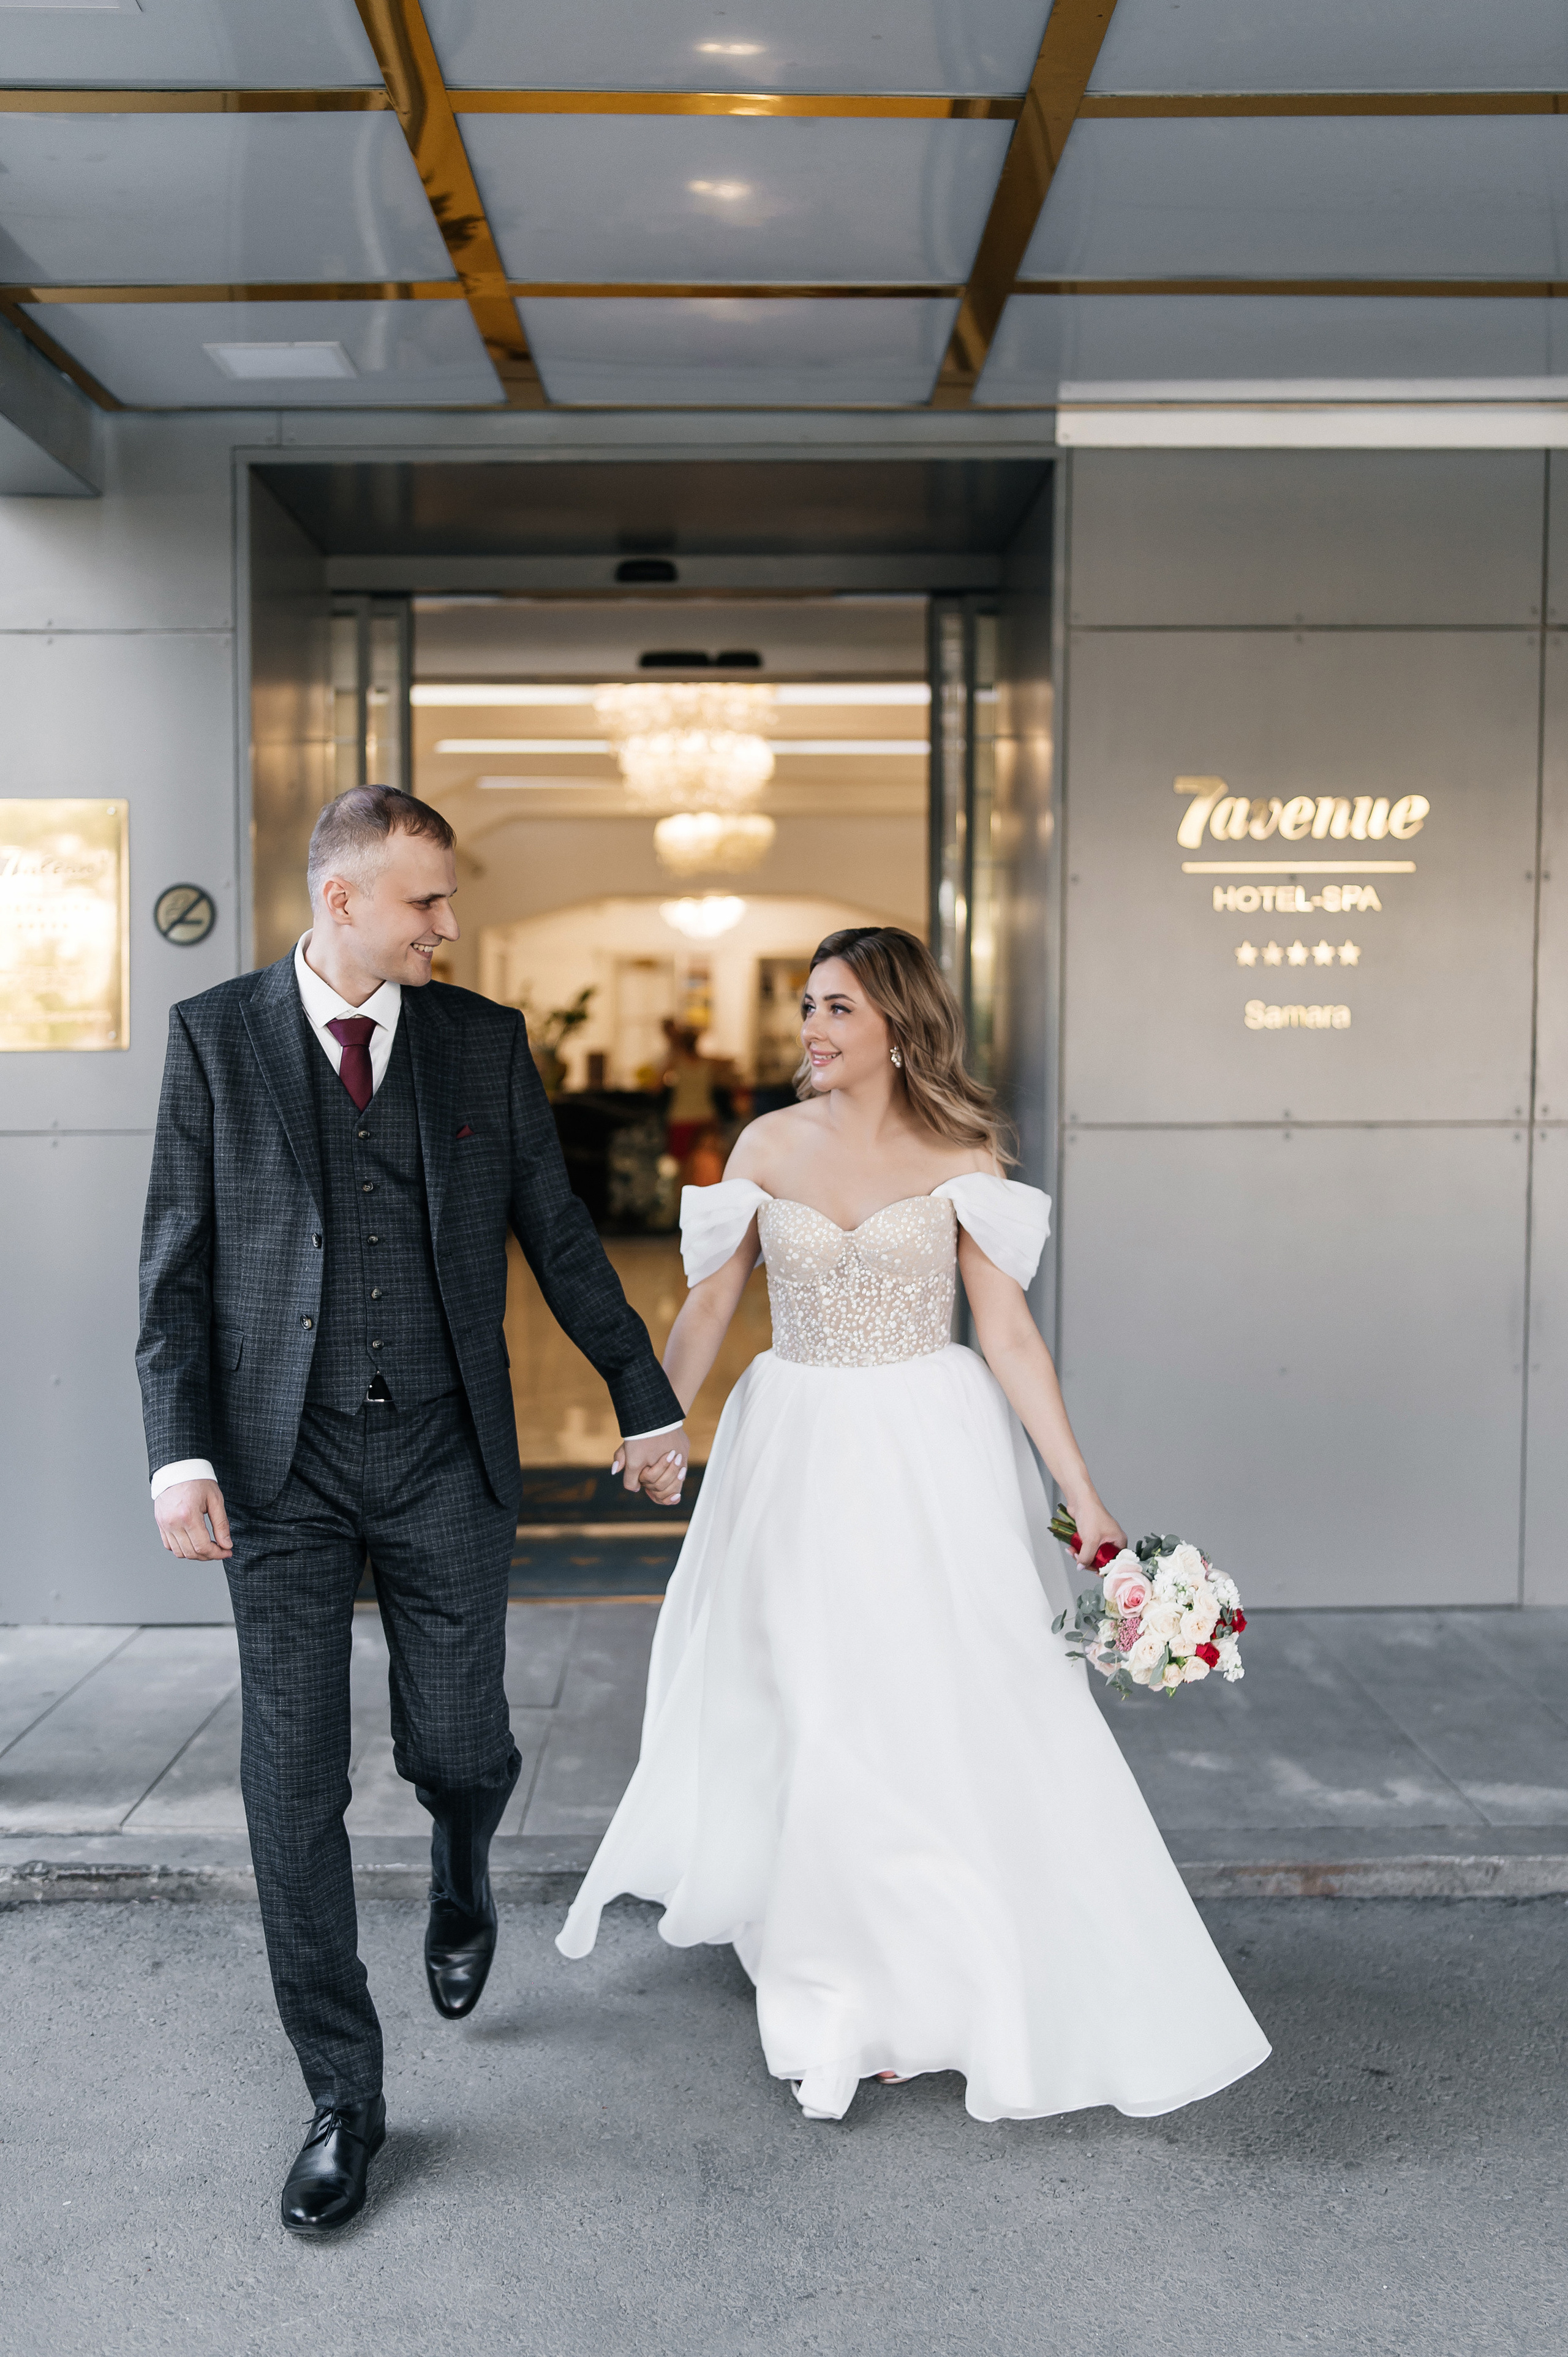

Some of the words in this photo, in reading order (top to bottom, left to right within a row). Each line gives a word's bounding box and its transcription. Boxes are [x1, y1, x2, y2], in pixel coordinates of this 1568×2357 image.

[1173, 775, 1430, 849] 7avenue
[1212, 885, 1382, 912] HOTEL-SPA
[1244, 999, 1352, 1029] Samara
